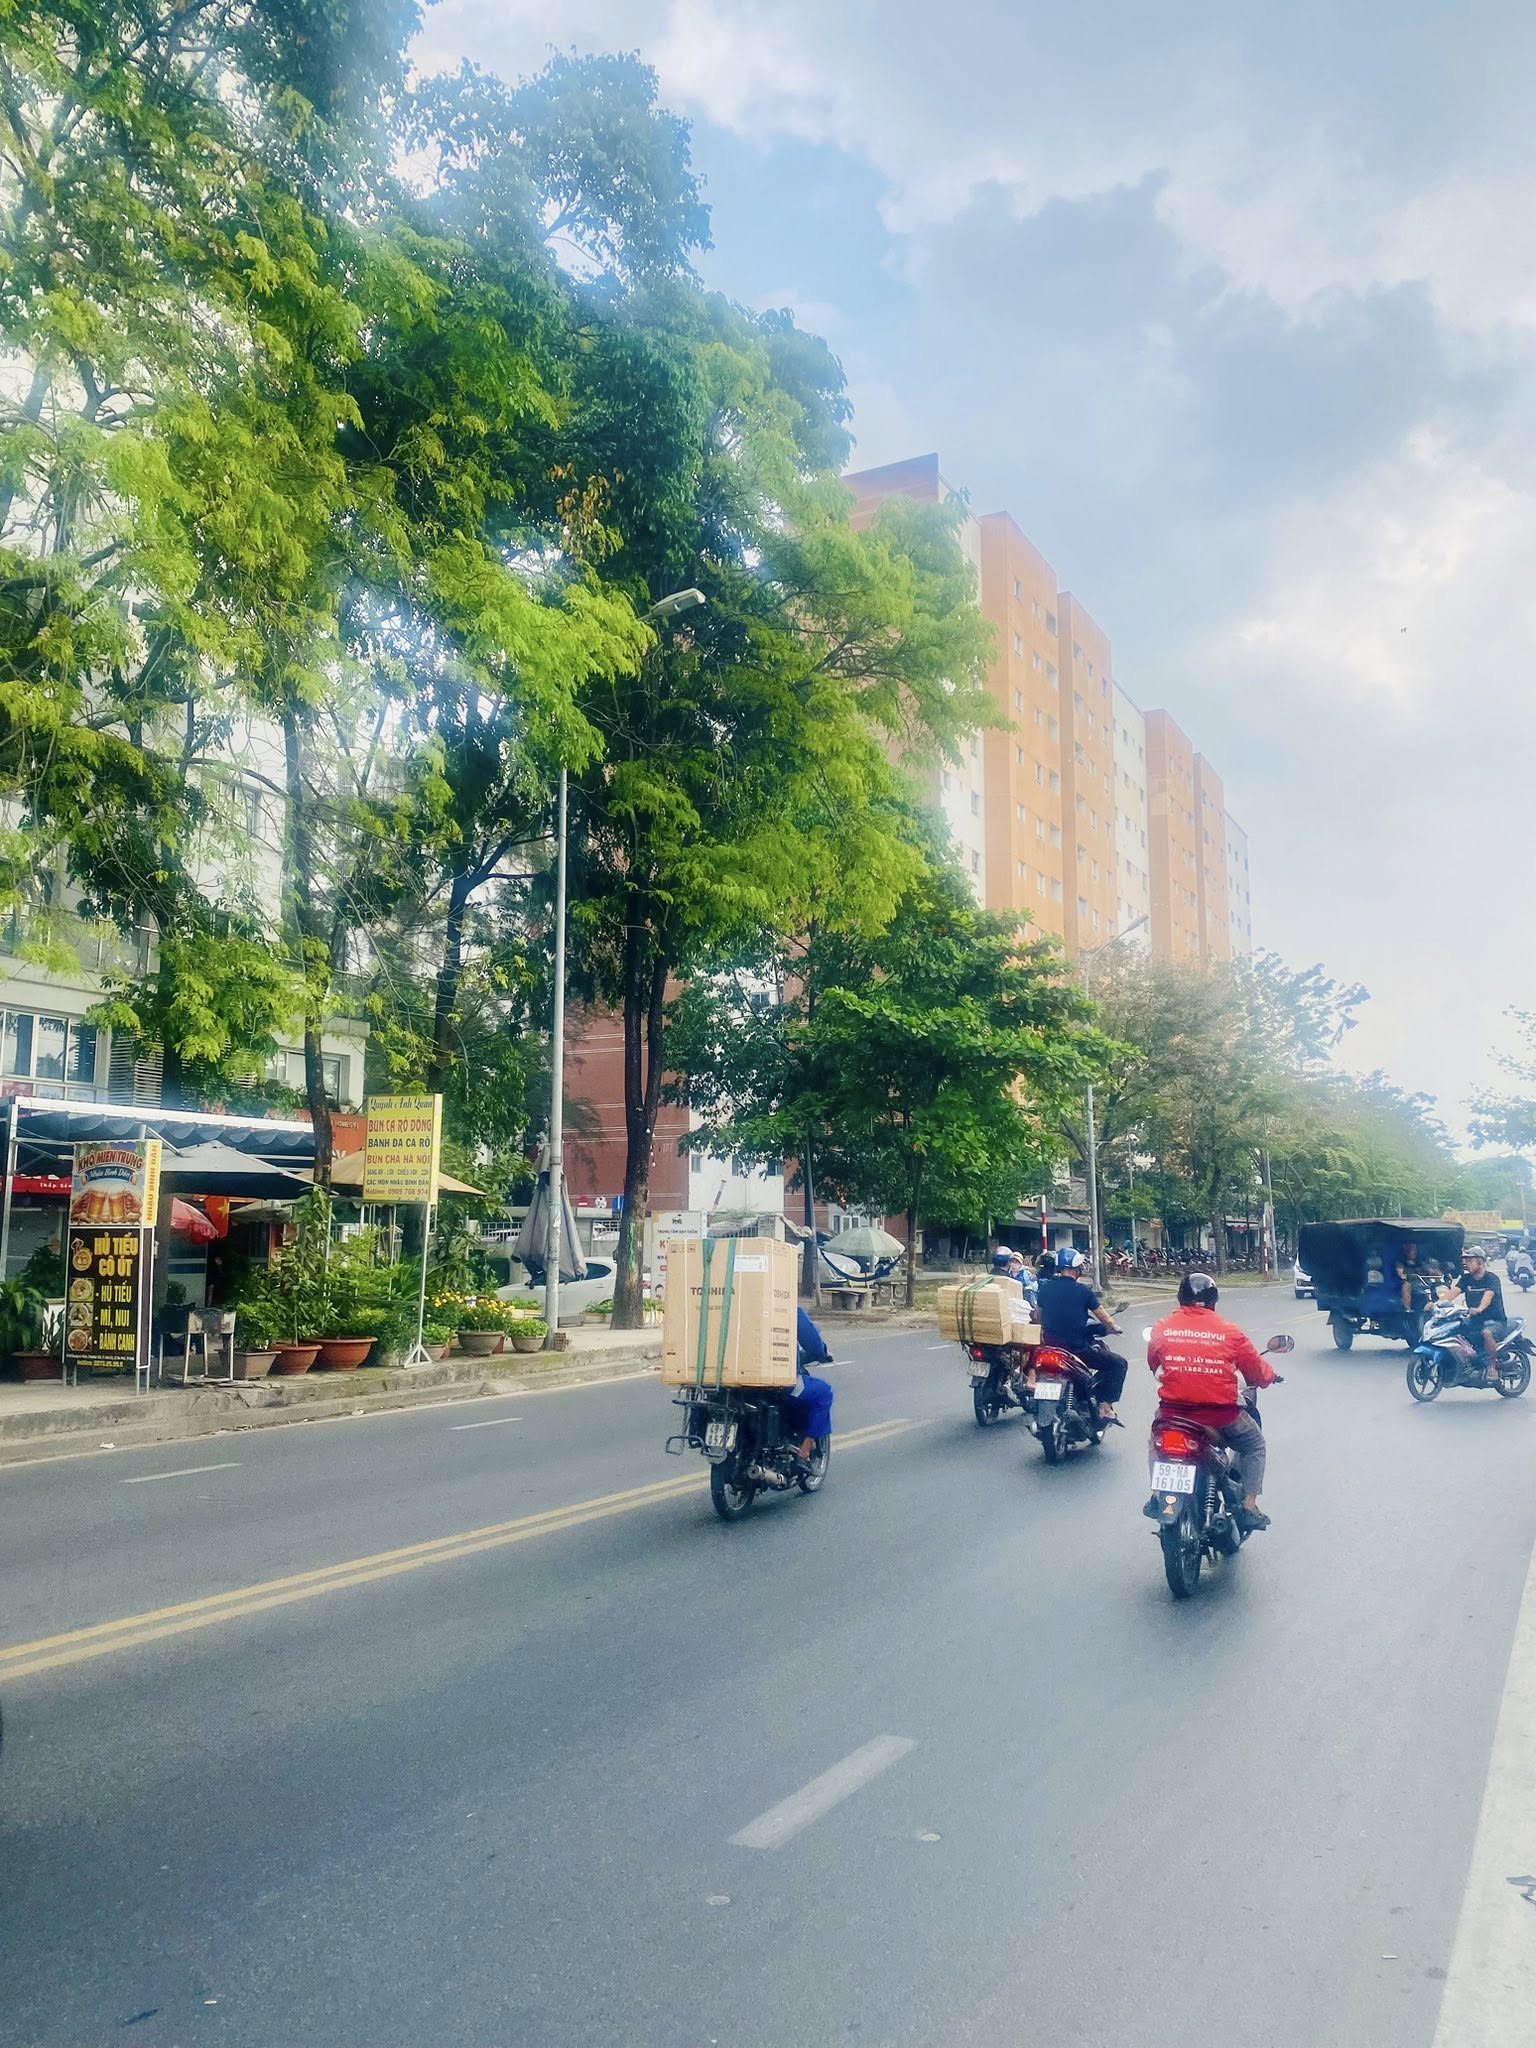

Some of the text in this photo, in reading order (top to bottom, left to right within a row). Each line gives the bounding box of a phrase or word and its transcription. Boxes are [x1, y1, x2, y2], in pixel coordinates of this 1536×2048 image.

[115, 1310, 130, 1326] NUI
[118, 1334, 135, 1350] CANH
[1156, 1477, 1190, 1491] 16105
